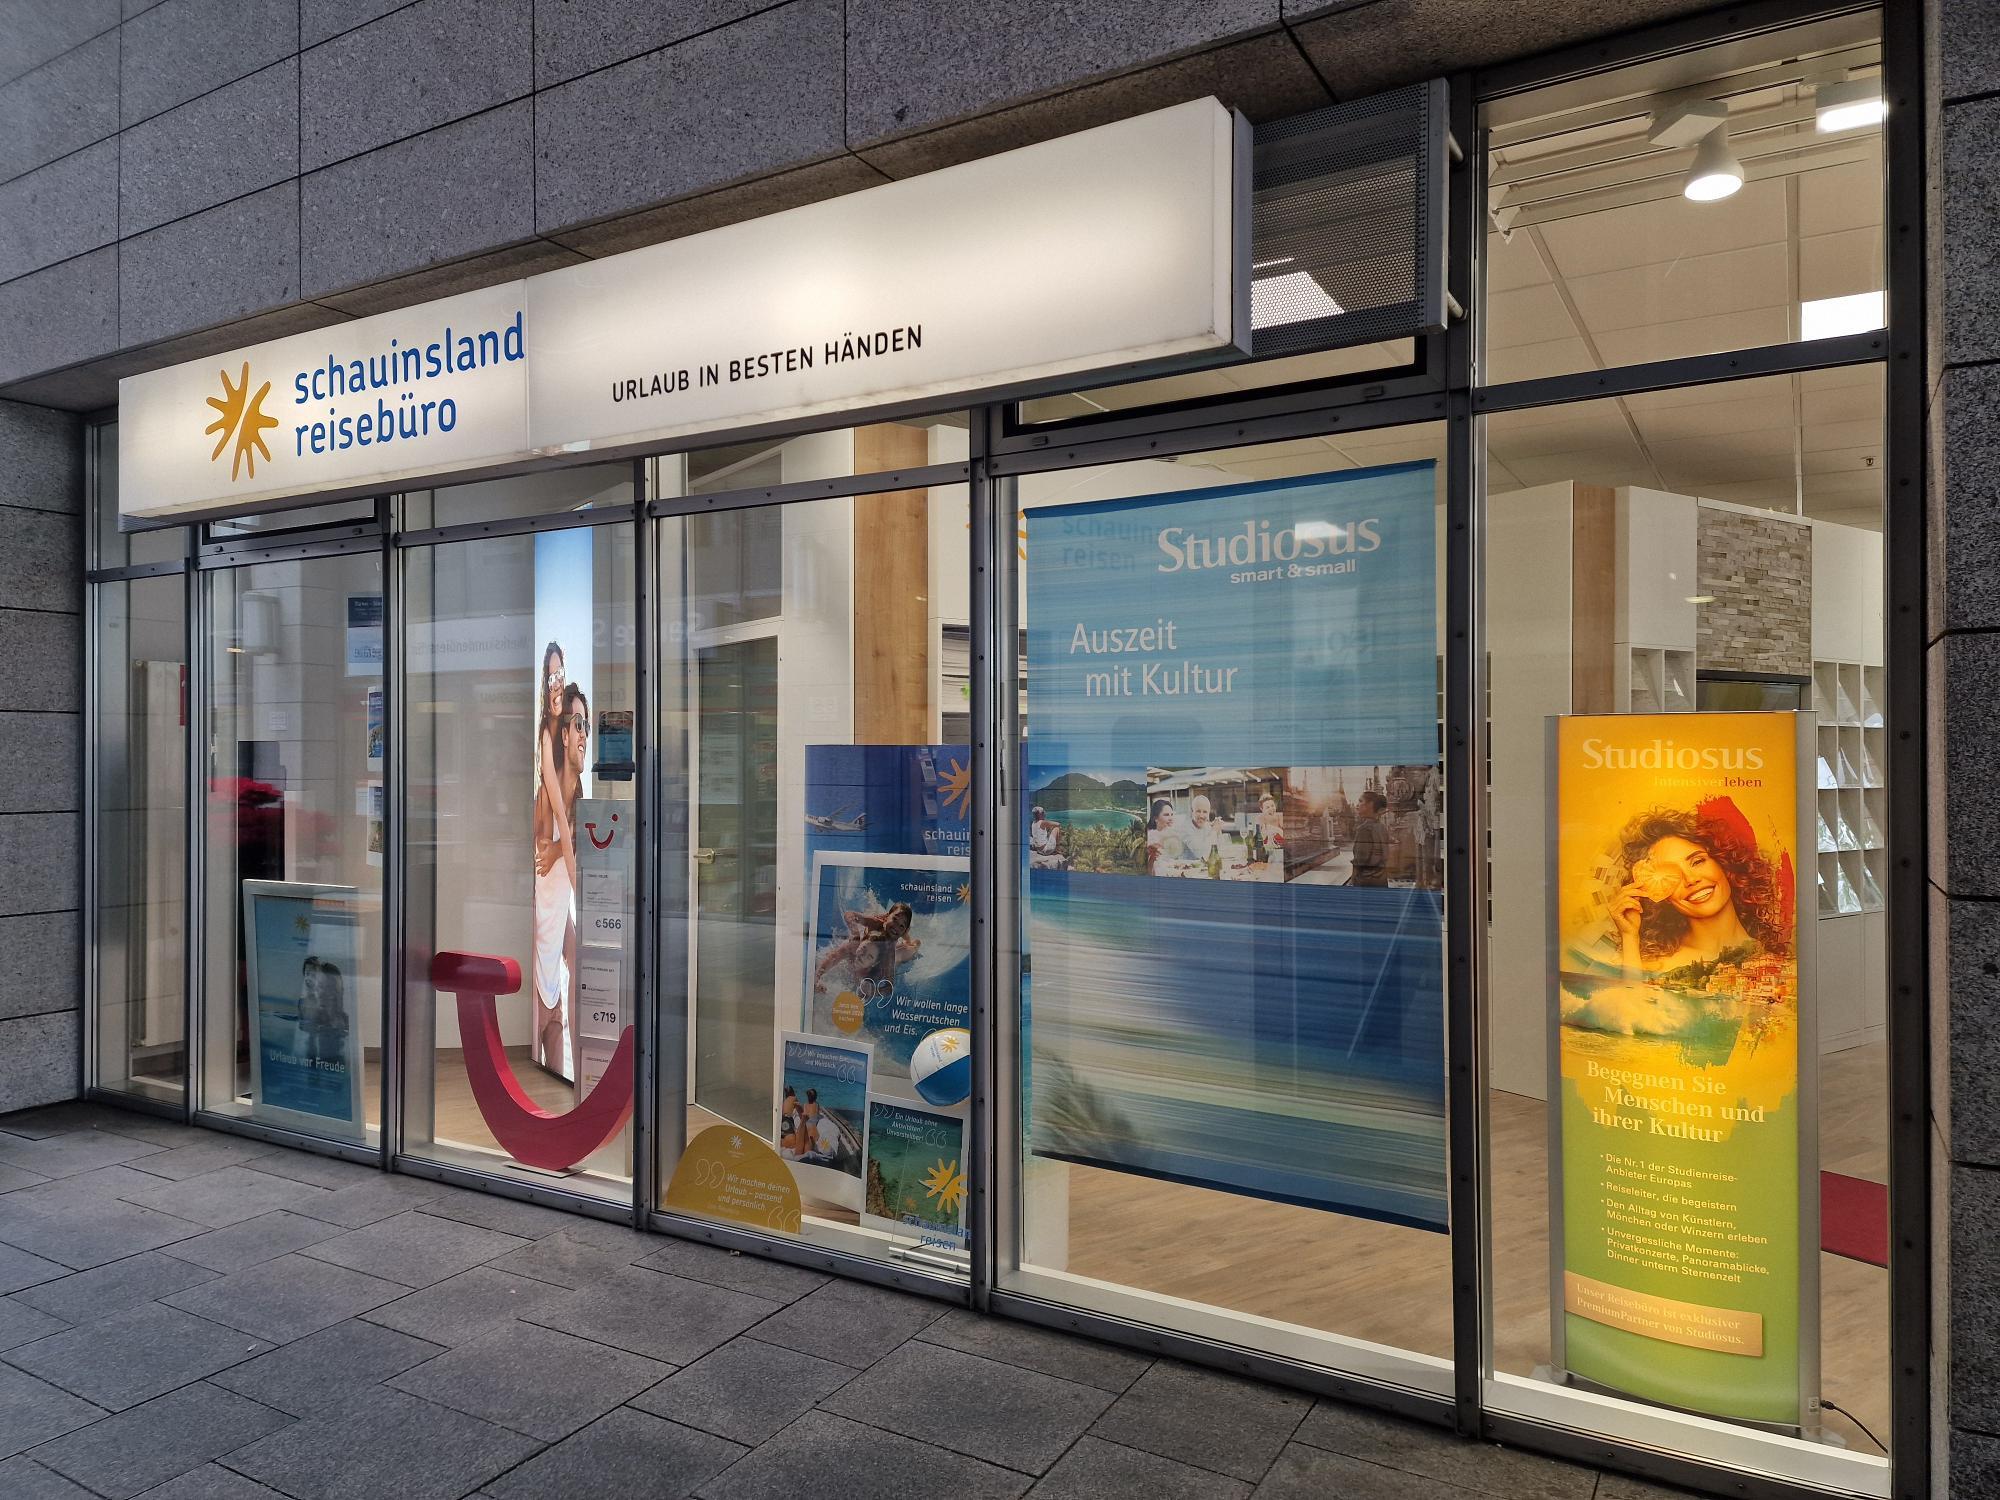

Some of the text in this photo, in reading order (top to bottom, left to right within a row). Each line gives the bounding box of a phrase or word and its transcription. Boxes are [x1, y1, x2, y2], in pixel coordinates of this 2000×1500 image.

[295, 311, 526, 404] schauinsland
[612, 324, 922, 402] URLAUB IN BESTEN HÄNDEN
[295, 393, 457, 457] reisebüro
[1157, 518, 1382, 573] Studiosus
[1230, 558, 1356, 584] smart & small
[1070, 618, 1177, 654] Auszeit
[1086, 660, 1240, 696] mit Kultur
[1582, 738, 1764, 770] Studiosus
[900, 882, 952, 893] schauinsland
[926, 893, 952, 903] reisen
[892, 1009, 960, 1027] Wasserrutschen
[896, 996, 969, 1015] Wir wollen lange
[884, 1023, 918, 1036] und Eis.
[315, 1056, 345, 1073] Freude
[1586, 1060, 1727, 1095] Begegnen Sie
[1604, 1086, 1765, 1123] Menschen und
[1592, 1106, 1724, 1143] ihrer Kultur
[1605, 1153, 1621, 1164] Die
[1648, 1160, 1666, 1172] der
[1668, 1165, 1738, 1182] Studienreise-
[1605, 1165, 1692, 1189] Anbieter Europas
[1606, 1181, 1737, 1212] Reiseleiter, die begeistern
[1606, 1199, 1737, 1230] Den Alltag von Künstlern,
[1606, 1209, 1768, 1245] Mönchen oder Winzern erleben
[920, 1235, 956, 1251] reisen
[1607, 1227, 1740, 1259] Unvergessliche Momente:
[1607, 1238, 1770, 1275] Privatkonzerte, Panoramablicke,
[1607, 1249, 1742, 1283] Dinner unterm Sternenzeit
[1576, 1283, 1741, 1330] Unser Reisebüro ist exklusiver
[1576, 1297, 1745, 1345] PremiumPartner von Studiosus.
